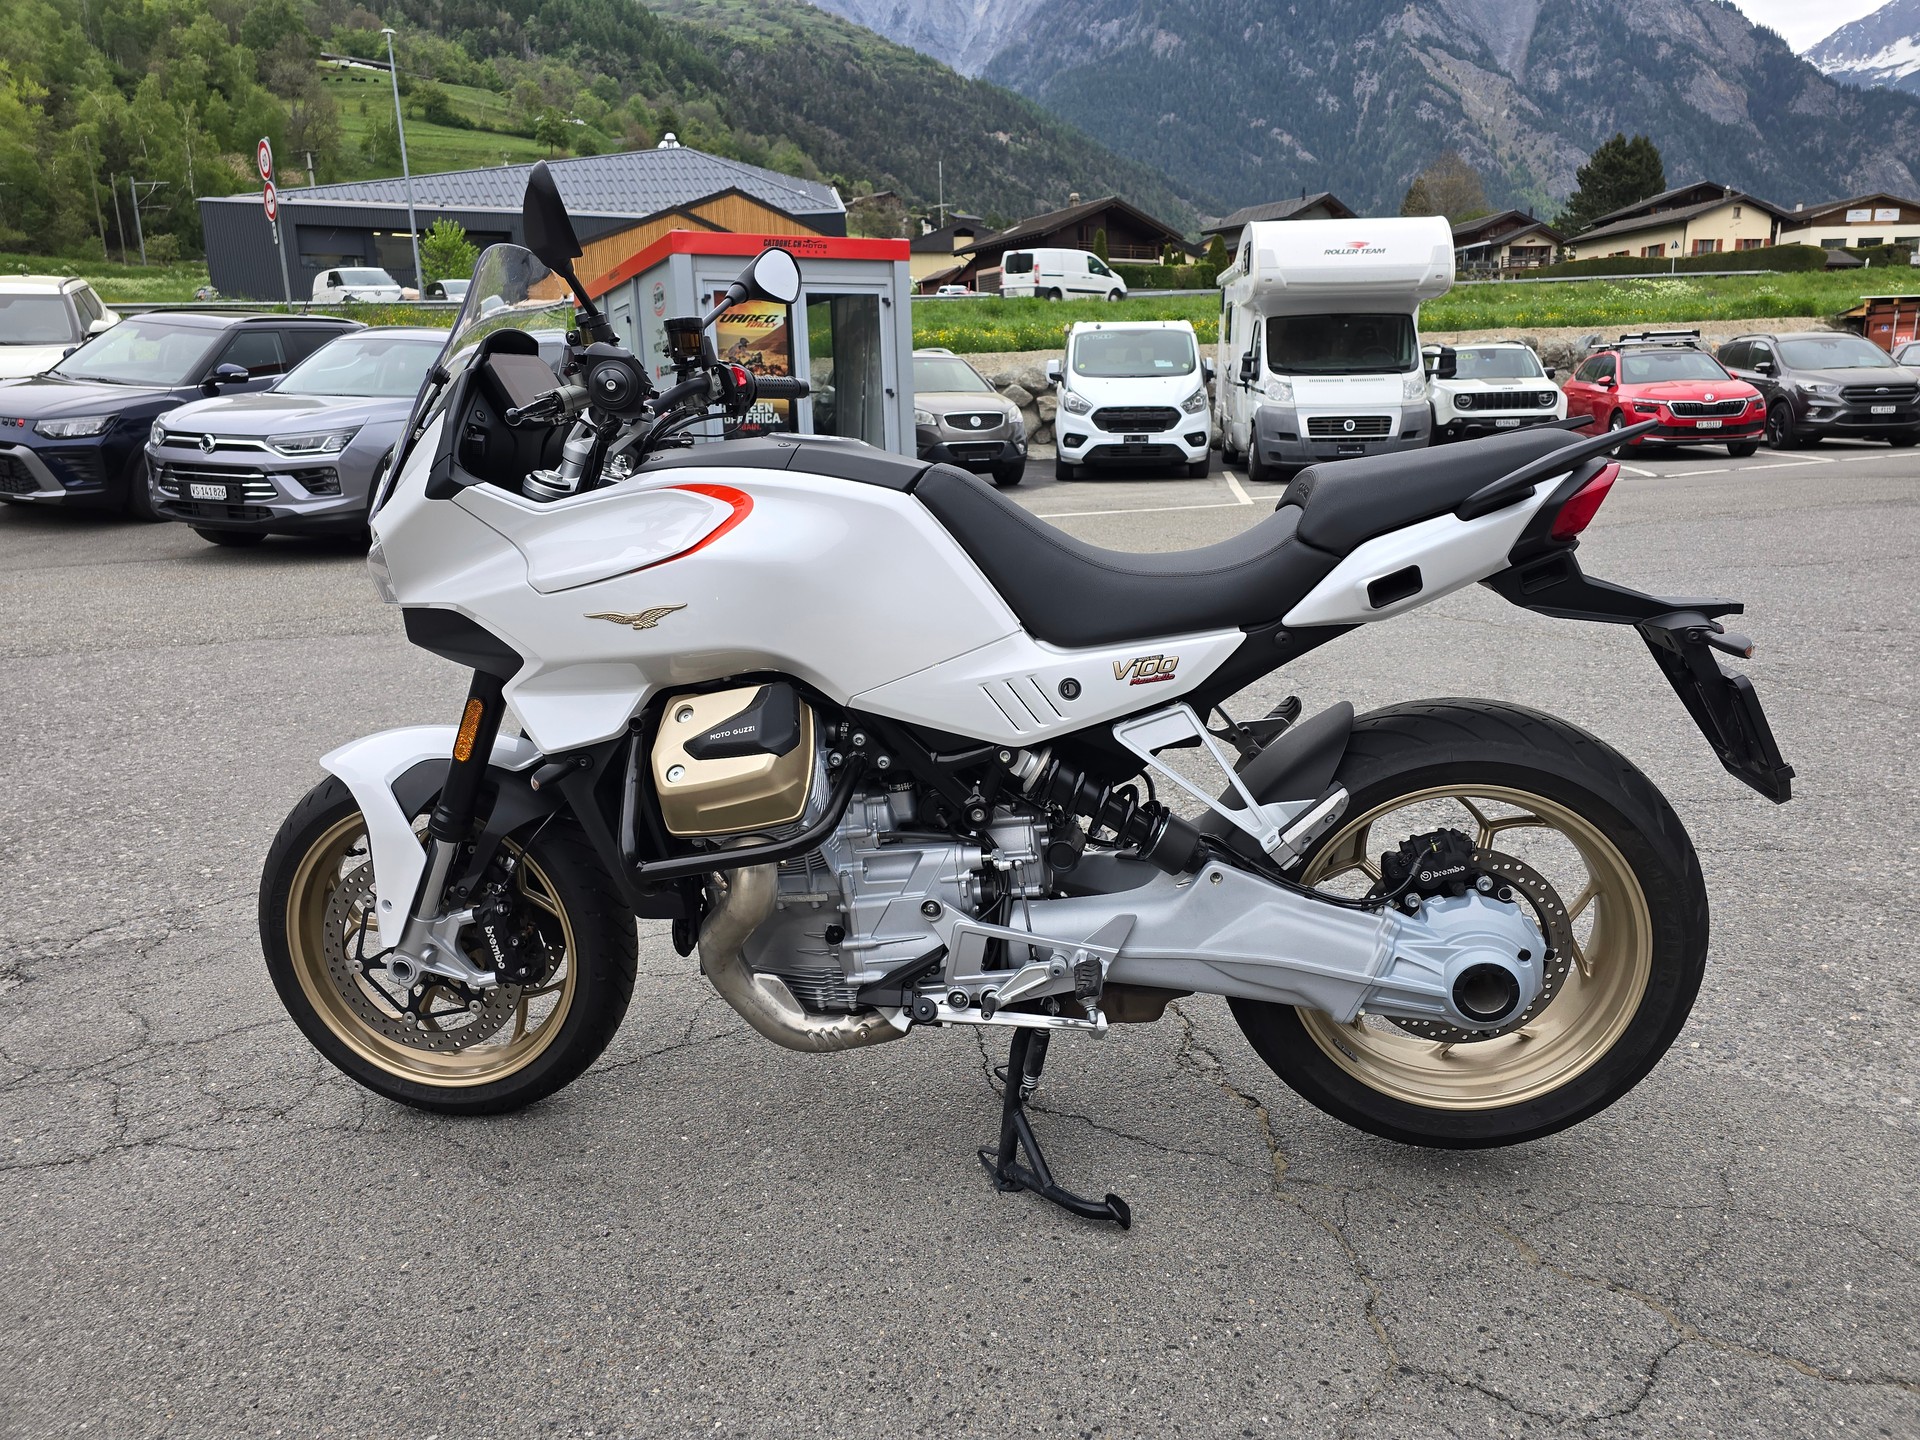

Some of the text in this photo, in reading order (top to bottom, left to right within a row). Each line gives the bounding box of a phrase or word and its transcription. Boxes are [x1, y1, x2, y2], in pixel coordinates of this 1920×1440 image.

[191, 486, 200, 495] VS
[1113, 656, 1179, 680] V100
[709, 725, 755, 740] MOTO GUZZI
[1433, 865, 1465, 878] brembo
[484, 925, 506, 969] brembo
